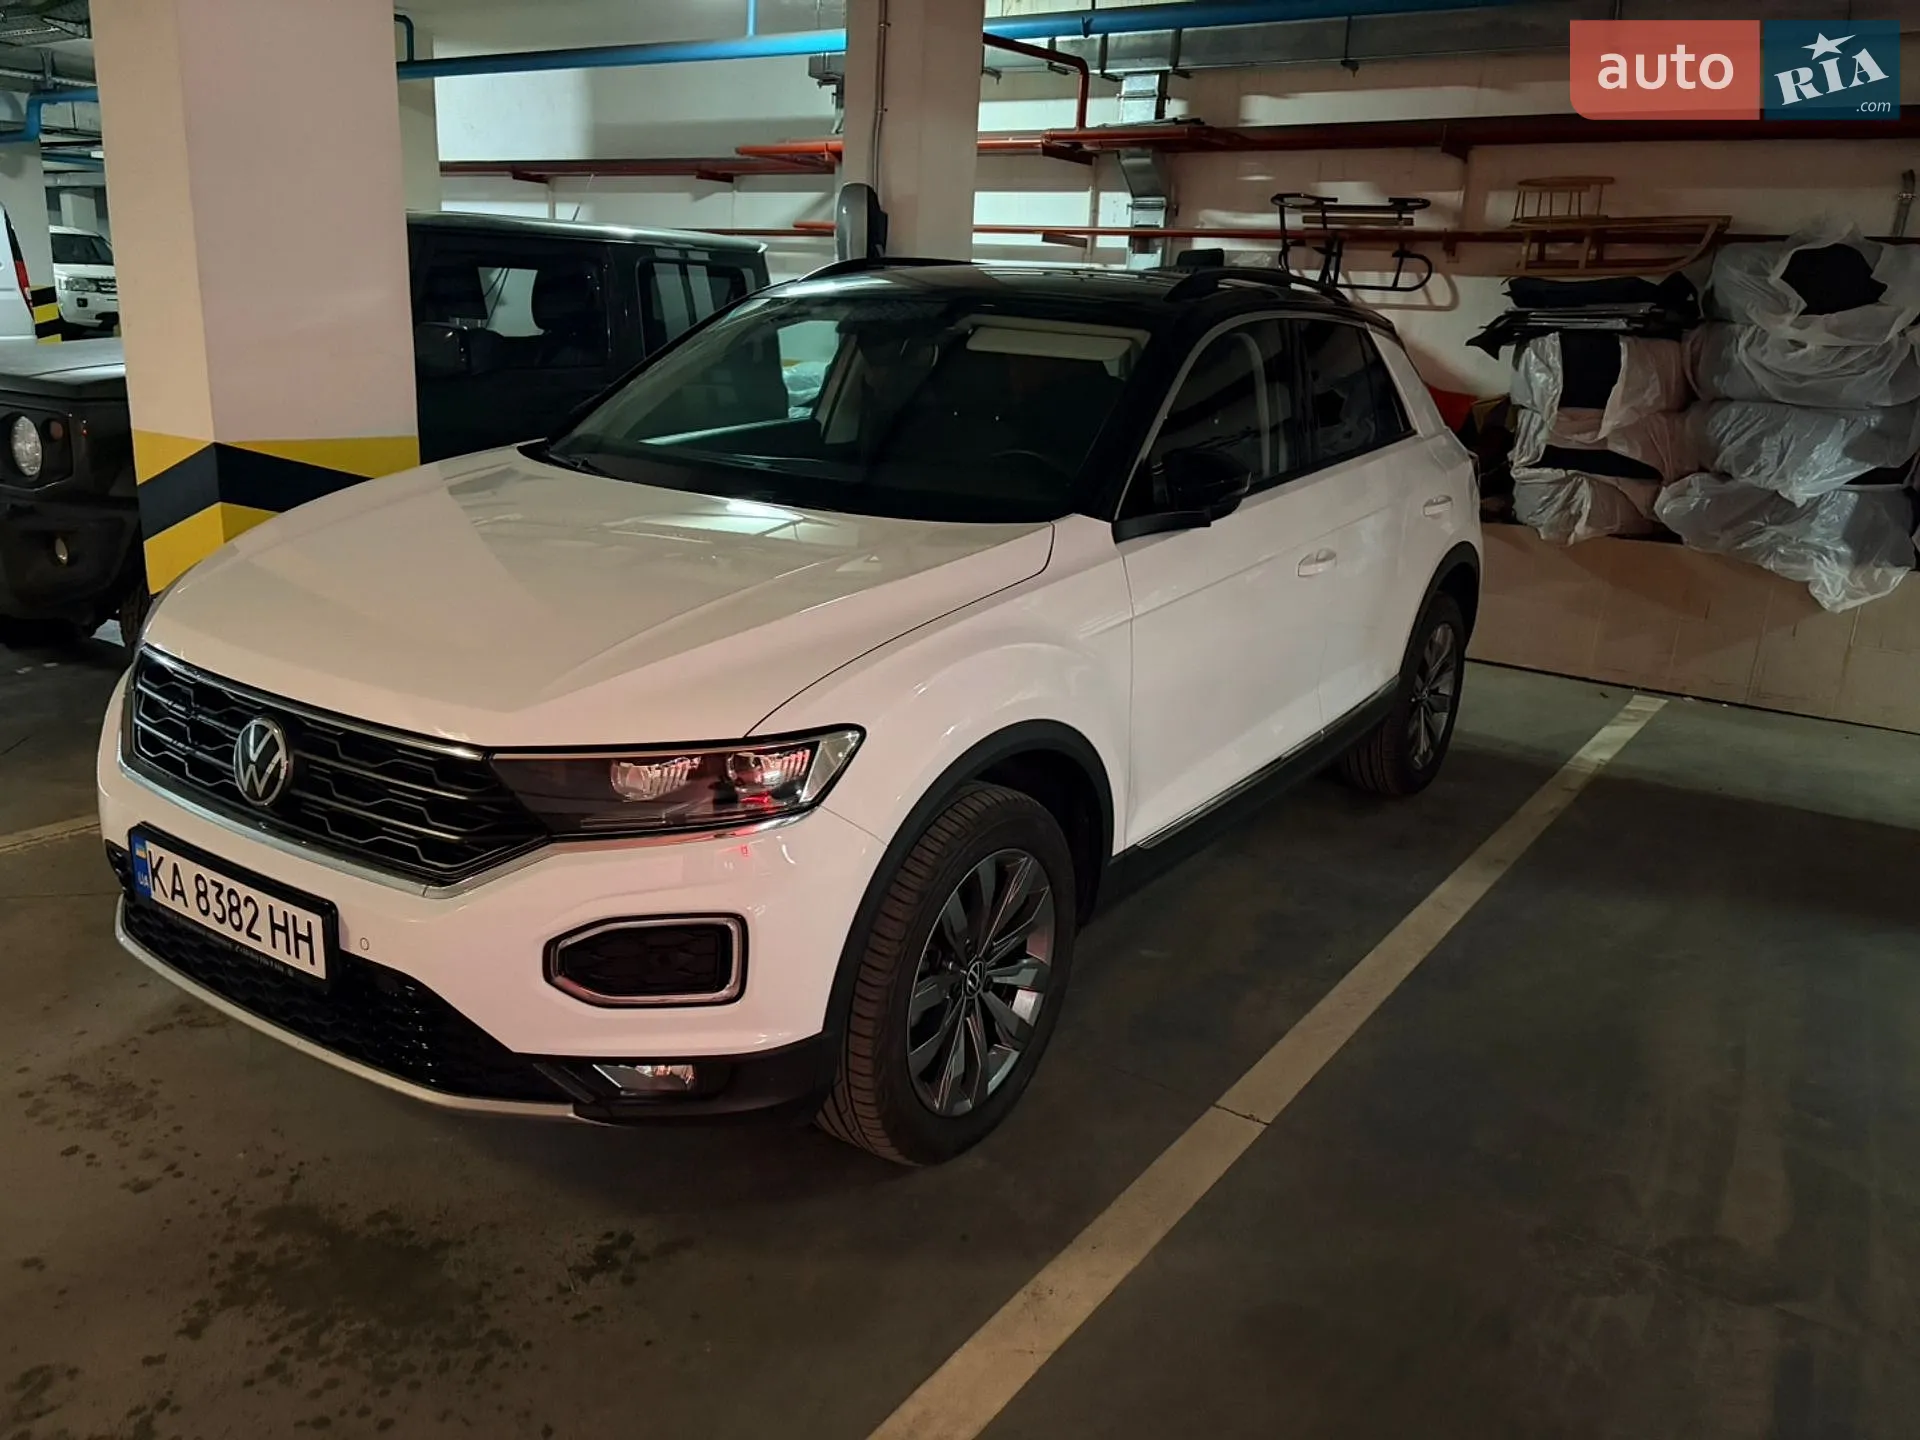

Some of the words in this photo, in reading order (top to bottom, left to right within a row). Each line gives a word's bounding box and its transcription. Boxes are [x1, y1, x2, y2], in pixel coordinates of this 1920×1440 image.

[236, 722, 284, 802] VW
[148, 850, 188, 908] KA
[195, 874, 262, 942] 8382
[268, 904, 315, 965] HH
